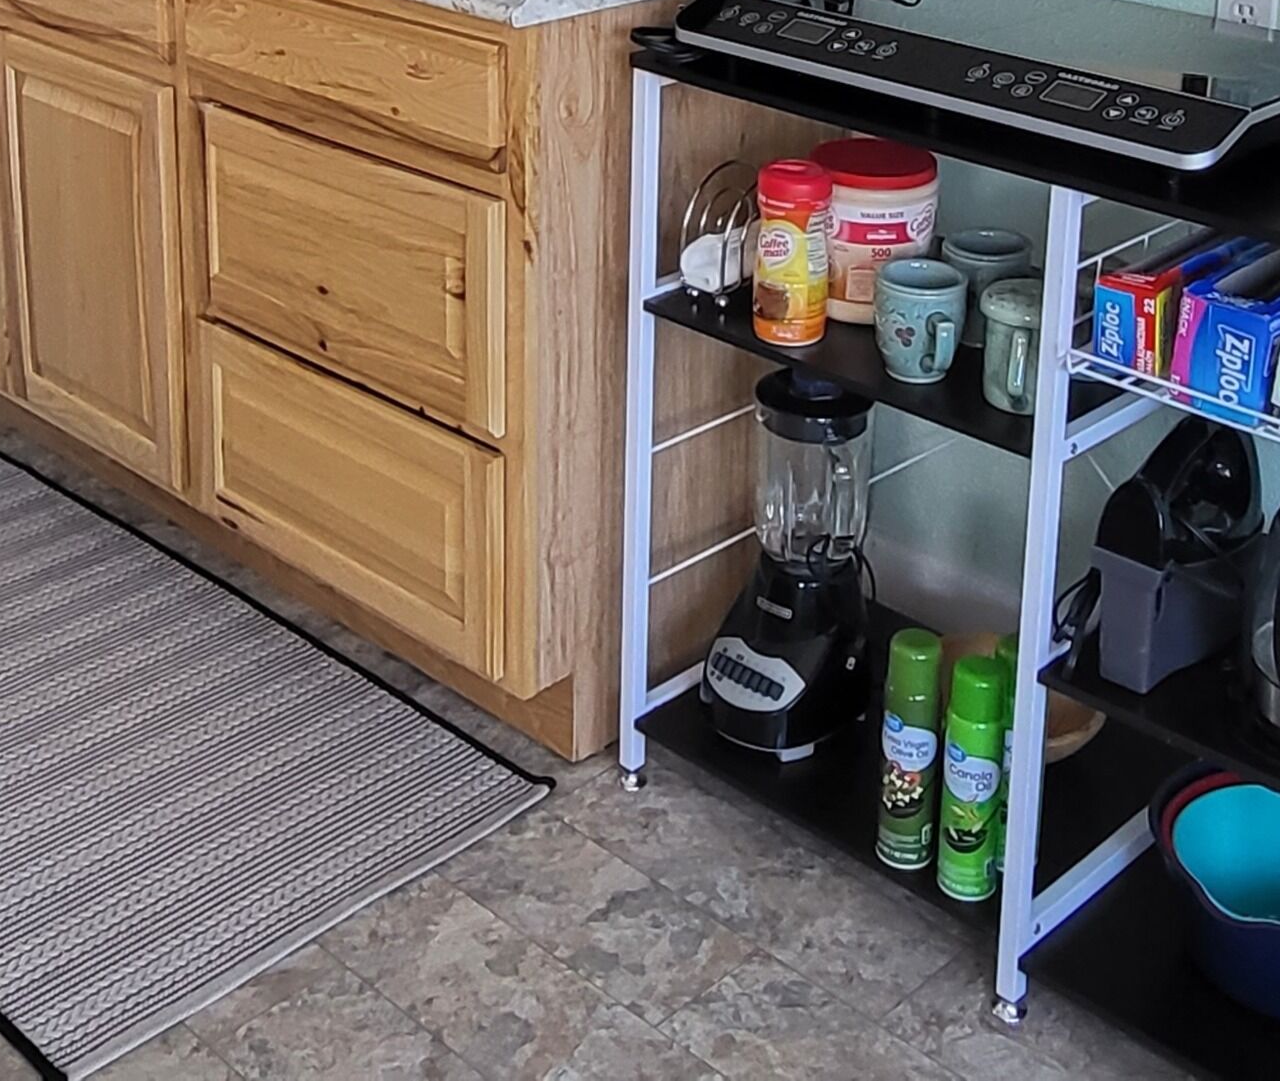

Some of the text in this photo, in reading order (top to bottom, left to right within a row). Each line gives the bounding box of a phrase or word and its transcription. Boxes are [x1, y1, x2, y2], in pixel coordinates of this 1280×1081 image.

[860, 211, 904, 219] VALUE SIZE
[760, 233, 789, 249] Coffee
[763, 248, 790, 258] mate
[871, 248, 892, 258] 500
[1143, 298, 1155, 315] 22
[1179, 295, 1191, 337] SNACK
[1101, 302, 1123, 358] Ziploc
[891, 745, 929, 759] Olive Oil
[950, 763, 993, 781] Canola
[975, 781, 992, 792] Oil
